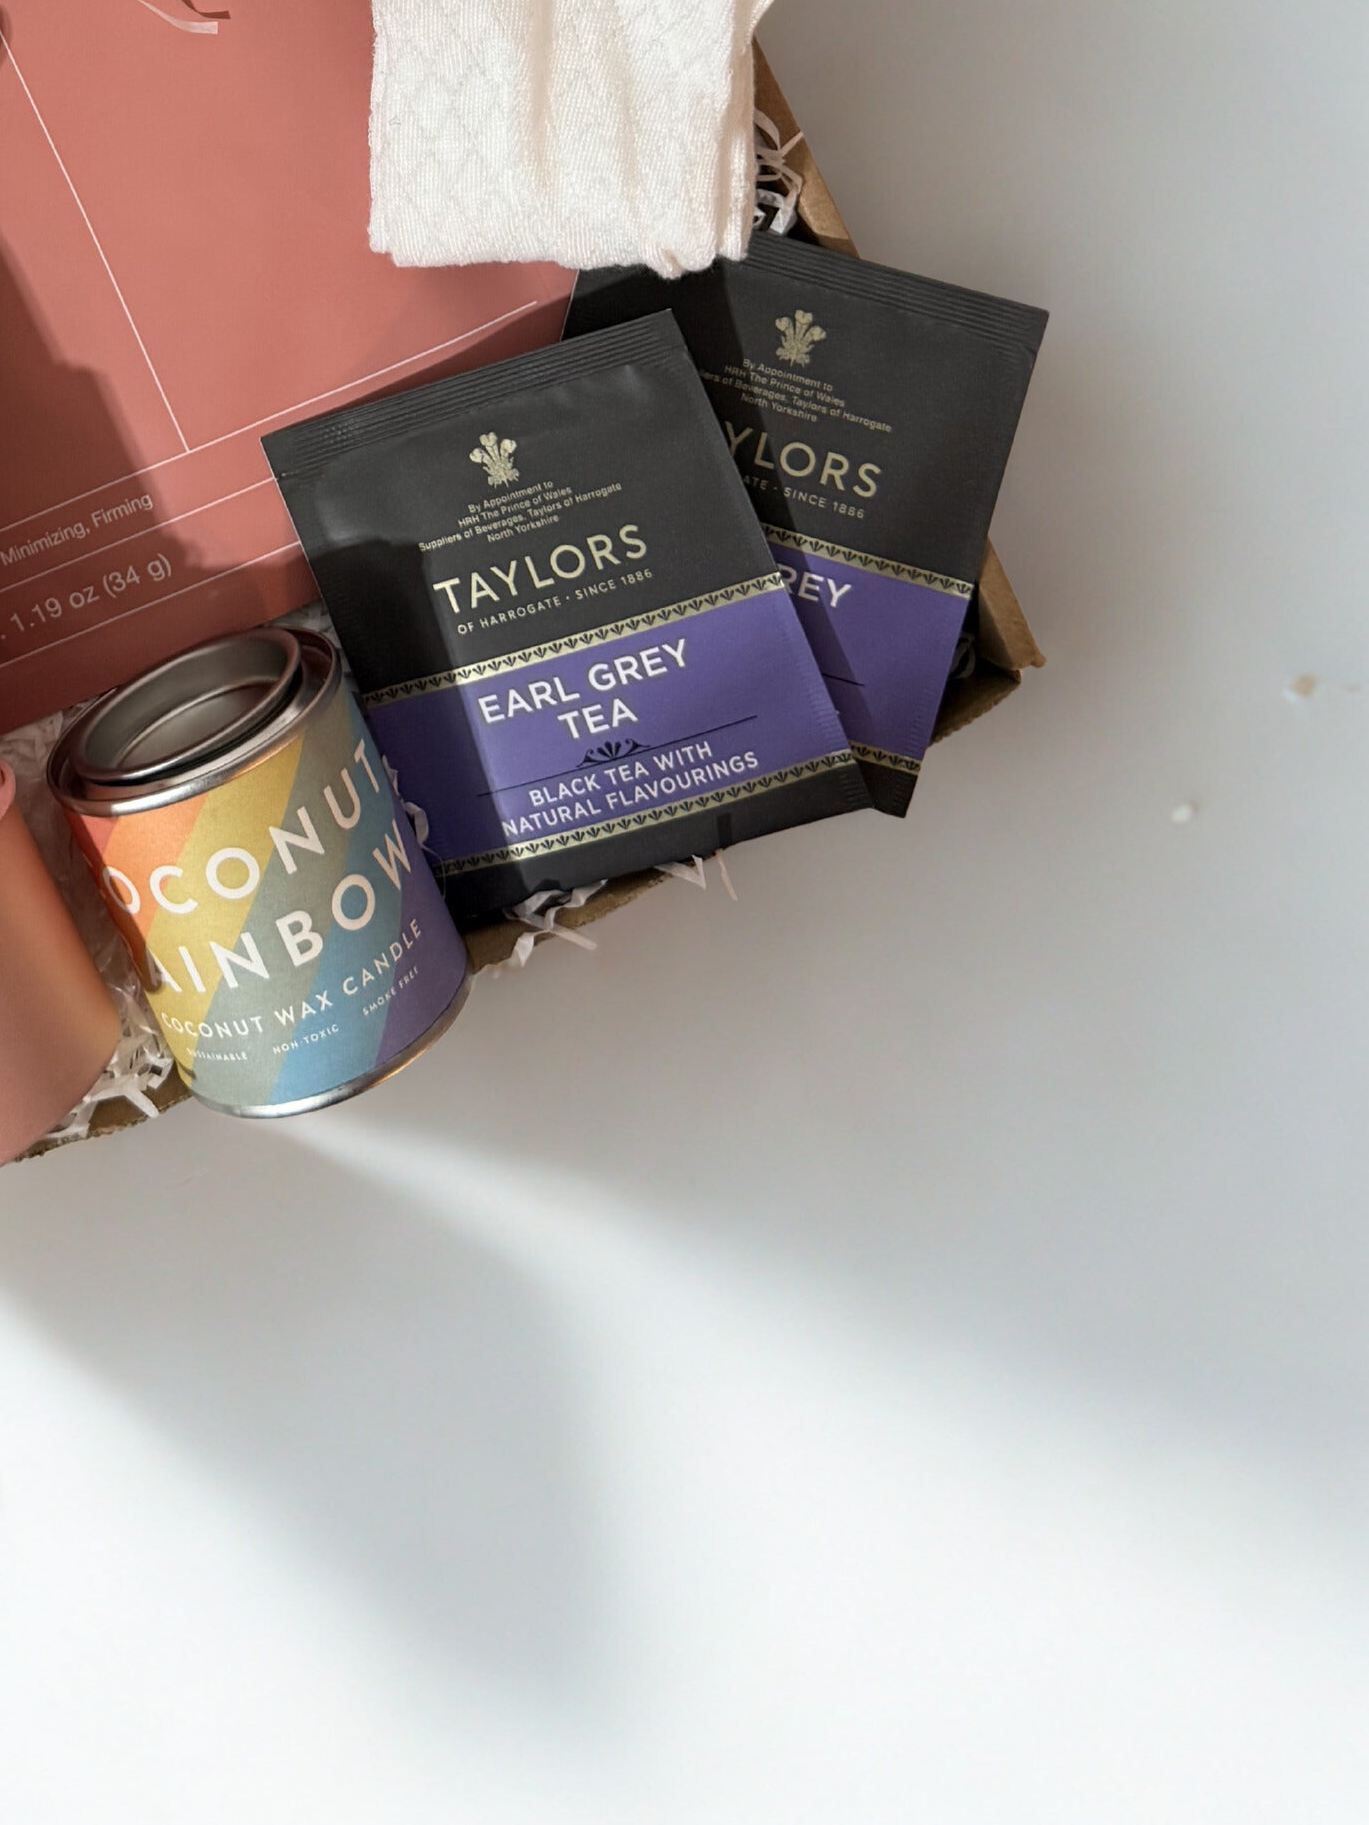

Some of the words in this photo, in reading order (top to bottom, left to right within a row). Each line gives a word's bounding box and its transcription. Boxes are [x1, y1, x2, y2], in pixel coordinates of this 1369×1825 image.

[743, 359, 756, 369] By
[757, 364, 821, 387] Appointment
[823, 382, 833, 391] to
[749, 372, 768, 385] The
[770, 378, 801, 394] Prince
[804, 388, 814, 397] of
[816, 392, 845, 407] Wales
[741, 392, 768, 408] North
[771, 402, 817, 423] Yorkshire
[792, 395, 827, 414] Taylors
[829, 408, 841, 417] of
[843, 411, 892, 433] Harrogate
[725, 420, 882, 498] YLORS
[418, 533, 462, 553] Suppliers
[464, 529, 473, 539] of
[527, 503, 562, 521] Taylors
[563, 497, 573, 507] of
[574, 482, 622, 503] Harrogate
[457, 514, 479, 528] HRH
[481, 509, 499, 521] The
[500, 499, 531, 517] Prince
[532, 496, 542, 506] of
[542, 486, 572, 502] Wales
[468, 503, 481, 514] By
[483, 484, 542, 509] Appointment
[543, 480, 553, 490] to
[784, 486, 826, 508] SINCE
[833, 502, 865, 519] 1886
[0, 521, 91, 567] Minimizing,
[91, 493, 153, 528] Firming
[487, 529, 514, 543] North
[514, 514, 559, 535] Yorkshire
[10, 597, 62, 633] 1.19
[69, 584, 100, 609] oz
[102, 565, 141, 599] (34
[146, 553, 172, 582] g)
[432, 524, 647, 615] TAYLORS
[777, 563, 852, 608] REY
[457, 622, 474, 635] OF
[480, 596, 562, 630] HARROGATE
[575, 579, 617, 600] SINCE
[620, 568, 653, 586] 1886
[476, 670, 581, 726] EARL
[588, 637, 690, 695] GREY
[557, 696, 639, 742] TEA
[502, 797, 602, 837] NATURAL
[605, 751, 760, 810] FLAVOURINGS
[528, 775, 602, 807] BLACK
[606, 760, 650, 788] TEA
[652, 740, 714, 775] WITH
[102, 738, 382, 915] OCONUT
[161, 1012, 264, 1039] COCONUT
[274, 990, 334, 1026] WAX
[342, 918, 423, 996] CANDLE
[362, 988, 397, 1017] SMOKE
[398, 965, 420, 989] FREE
